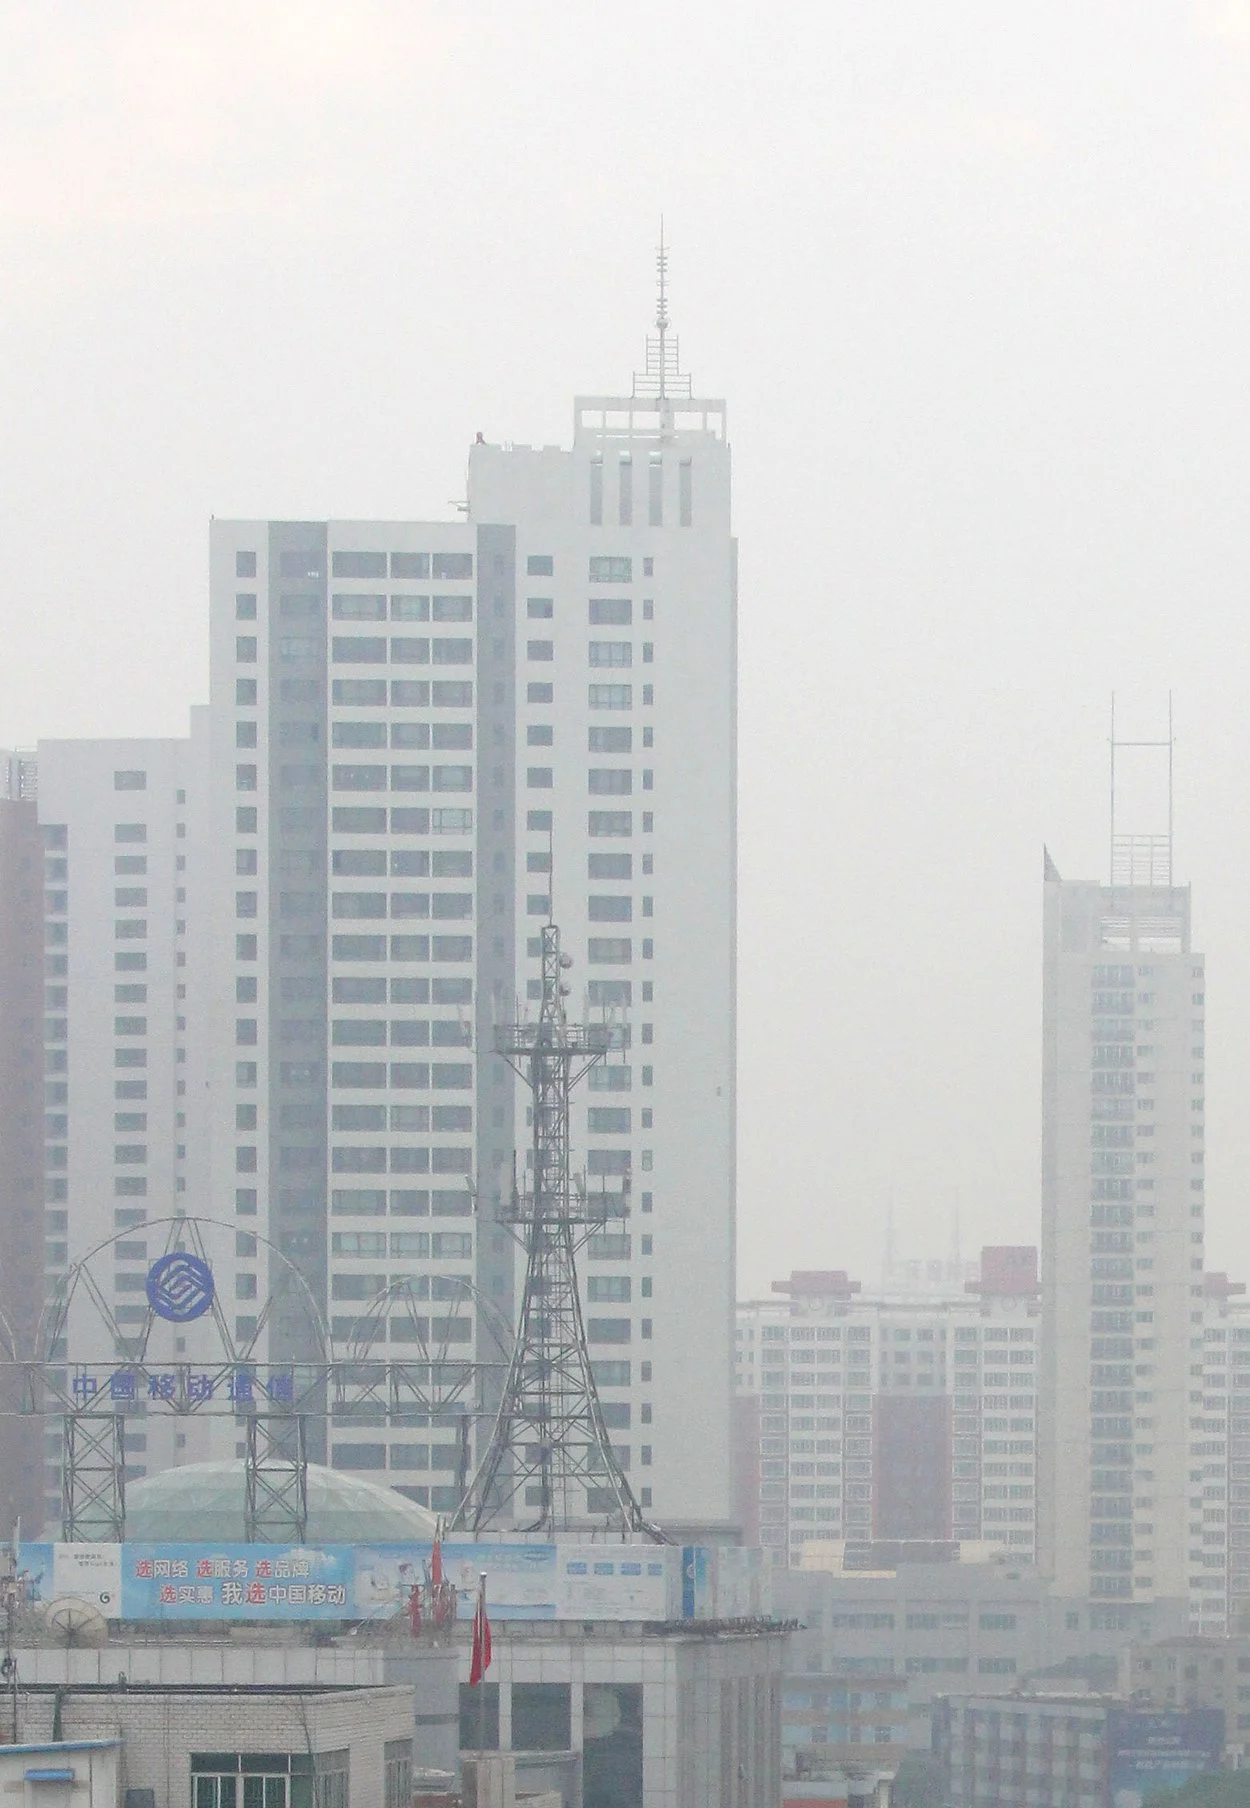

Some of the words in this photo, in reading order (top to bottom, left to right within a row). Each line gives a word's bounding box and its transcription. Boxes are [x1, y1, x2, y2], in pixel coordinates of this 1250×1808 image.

[73, 1371, 294, 1400] 中国移动通信
[136, 1560, 188, 1578] 选网络
[196, 1560, 249, 1578] 选服务
[255, 1560, 309, 1578] 选品牌
[160, 1584, 213, 1604] 选实惠
